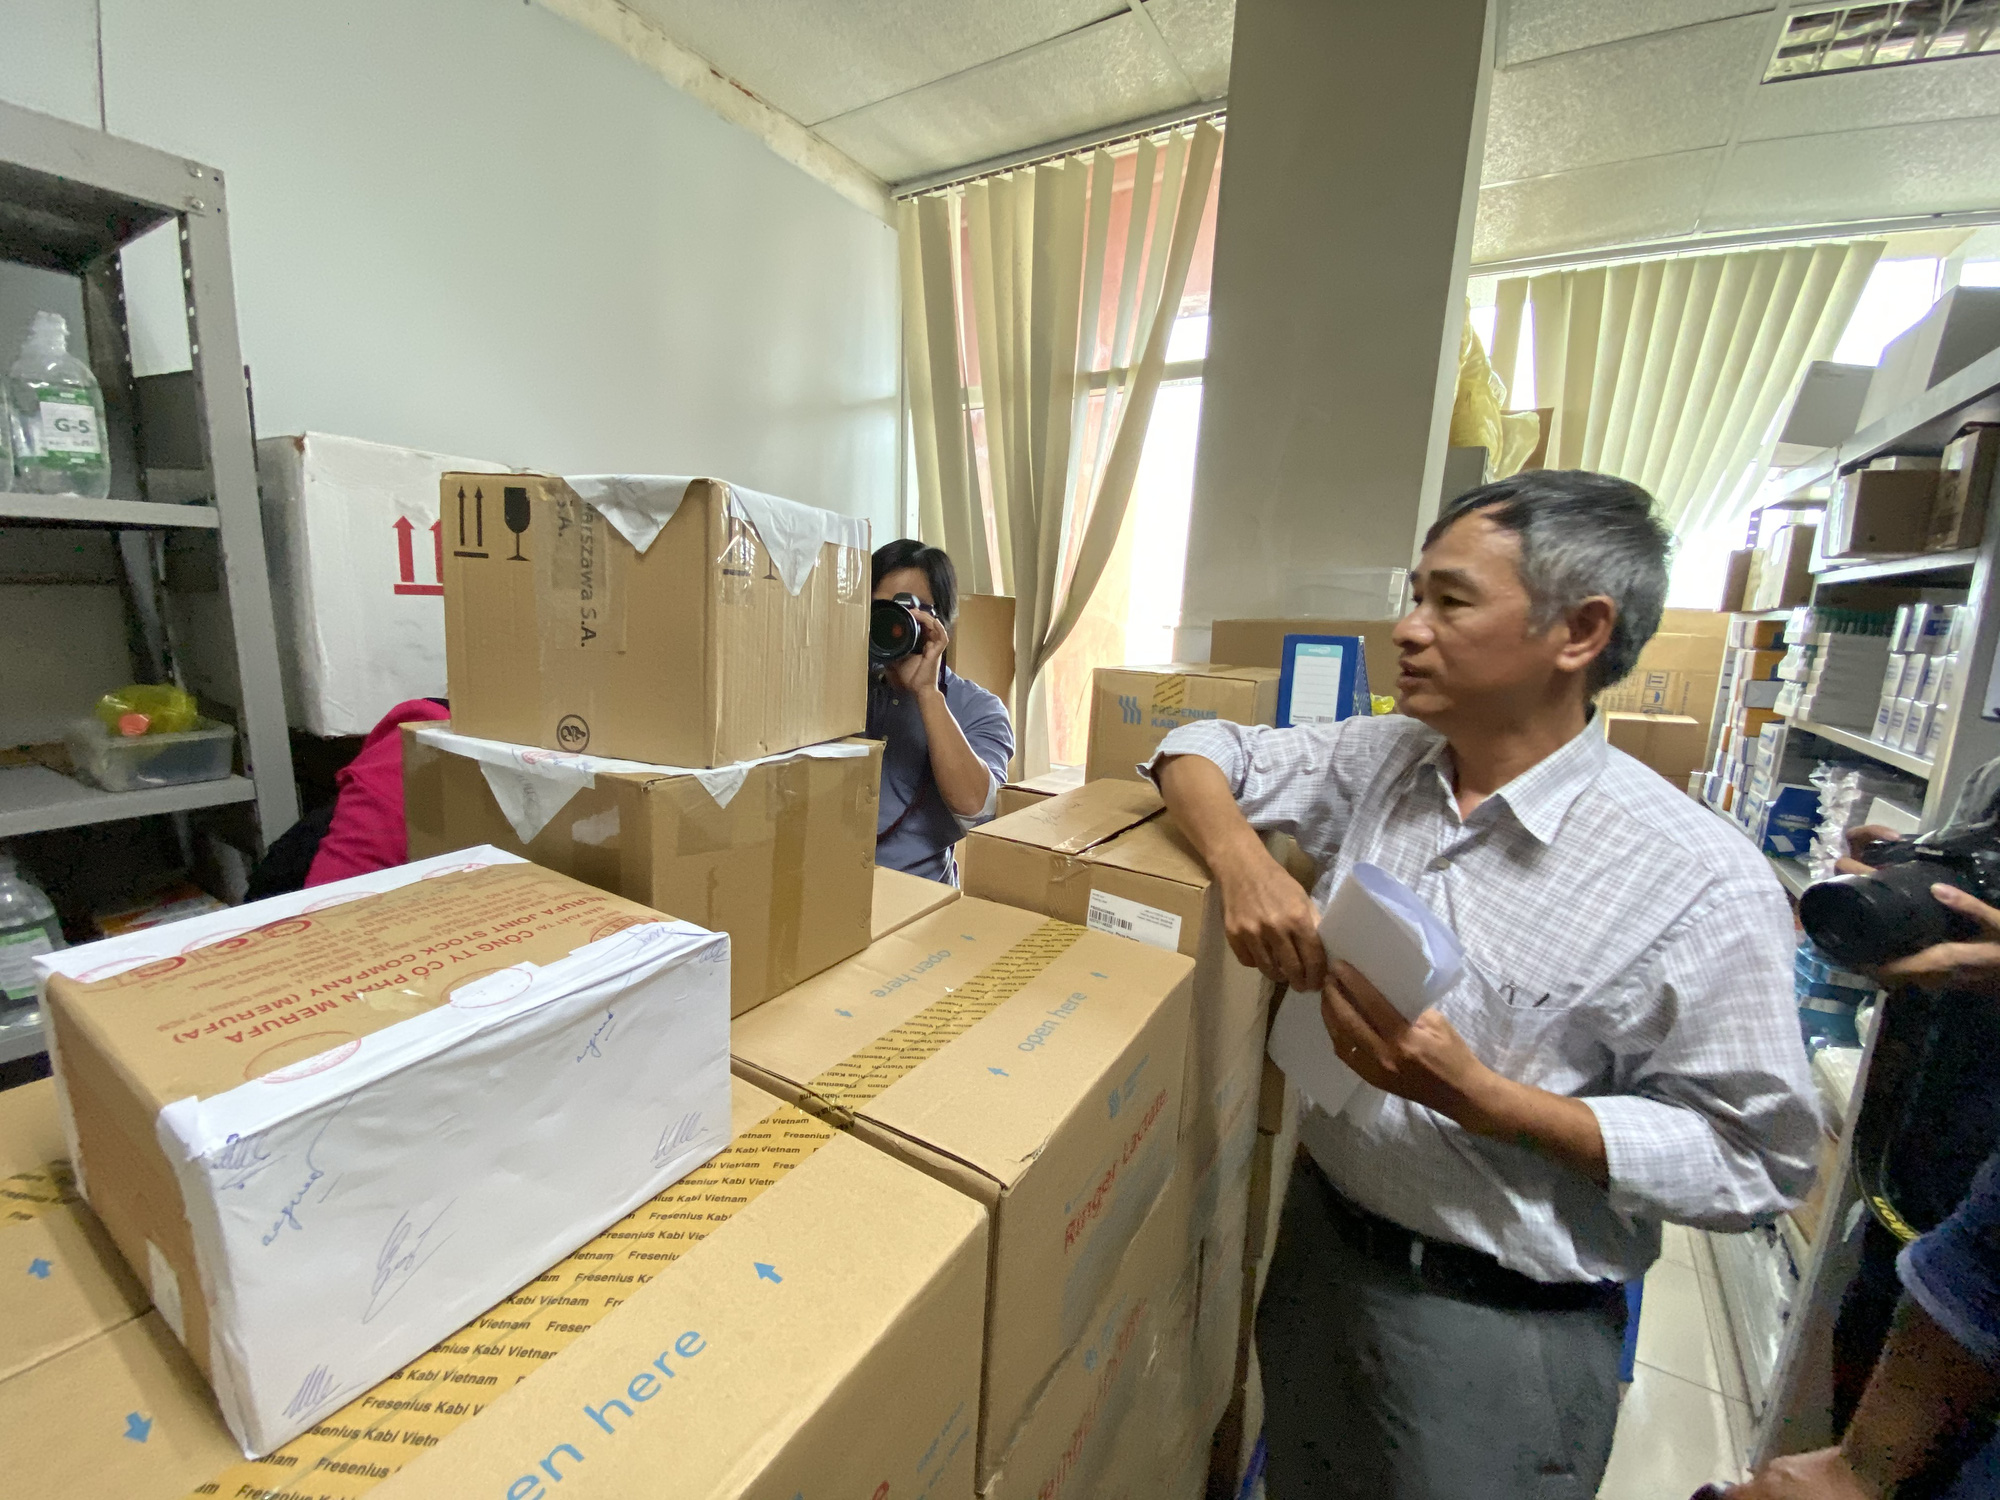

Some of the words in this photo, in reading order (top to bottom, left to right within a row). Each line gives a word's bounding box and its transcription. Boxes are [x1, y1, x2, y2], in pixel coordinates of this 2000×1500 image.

[581, 608, 597, 647] S.A.
[538, 894, 609, 916] MERUFA
[486, 913, 544, 933] JOINT
[416, 930, 489, 956] STOCK
[473, 929, 538, 953] CÔNG
[443, 949, 478, 963] TY
[909, 951, 951, 974] open
[304, 953, 419, 997] COMPANY
[870, 973, 918, 998] here
[169, 993, 304, 1044] (MERUFA)
[222, 999, 339, 1045] MERUFA
[1018, 1020, 1060, 1051] open
[1046, 992, 1087, 1019] here
[783, 1132, 831, 1140] Fresenius
[735, 1146, 758, 1154] Kabi
[761, 1145, 801, 1154] Vietnam
[721, 1177, 746, 1185] Kabi
[676, 1194, 701, 1203] Kabi
[704, 1194, 748, 1203] Vietnam
[649, 1212, 703, 1221] Fresenius
[657, 1230, 685, 1240] Kabi
[627, 1250, 680, 1262] Freseniu
[574, 1273, 634, 1283] Fresenius
[540, 1295, 589, 1307] Vietnam
[479, 1319, 531, 1330] Vietnam
[473, 1344, 504, 1357] Kabi
[407, 1370, 440, 1382] Kabi
[442, 1371, 498, 1386] Vietnam
[583, 1330, 707, 1435] here
[361, 1396, 432, 1413] Fresenius
[433, 1400, 470, 1416] Kabi
[362, 1427, 401, 1443] Kabi
[314, 1456, 390, 1479] Fresenius
